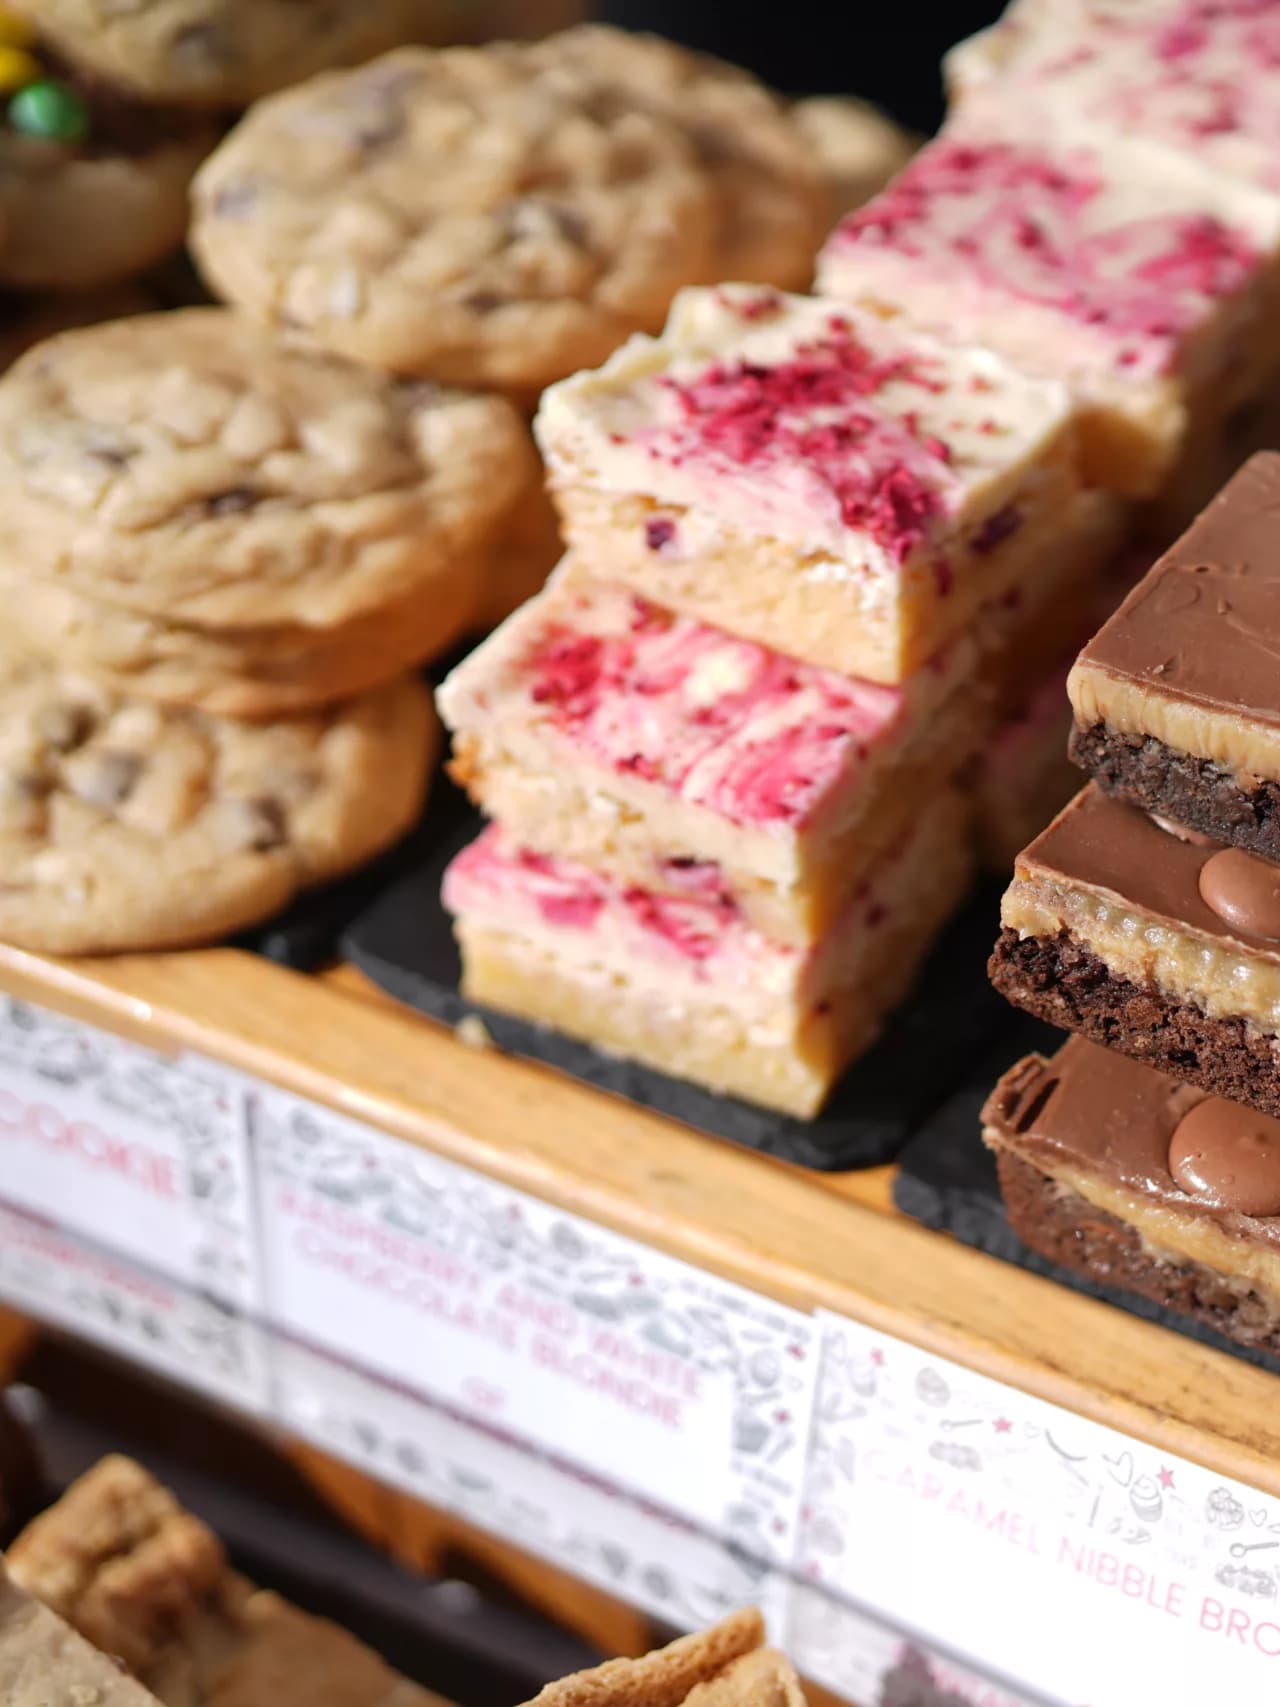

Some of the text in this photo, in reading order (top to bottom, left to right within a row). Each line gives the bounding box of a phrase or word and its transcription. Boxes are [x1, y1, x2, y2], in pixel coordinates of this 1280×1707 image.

[497, 1281, 579, 1337] AND
[862, 1447, 1040, 1555] CARAMEL
[1057, 1535, 1186, 1618] NIBBLE
